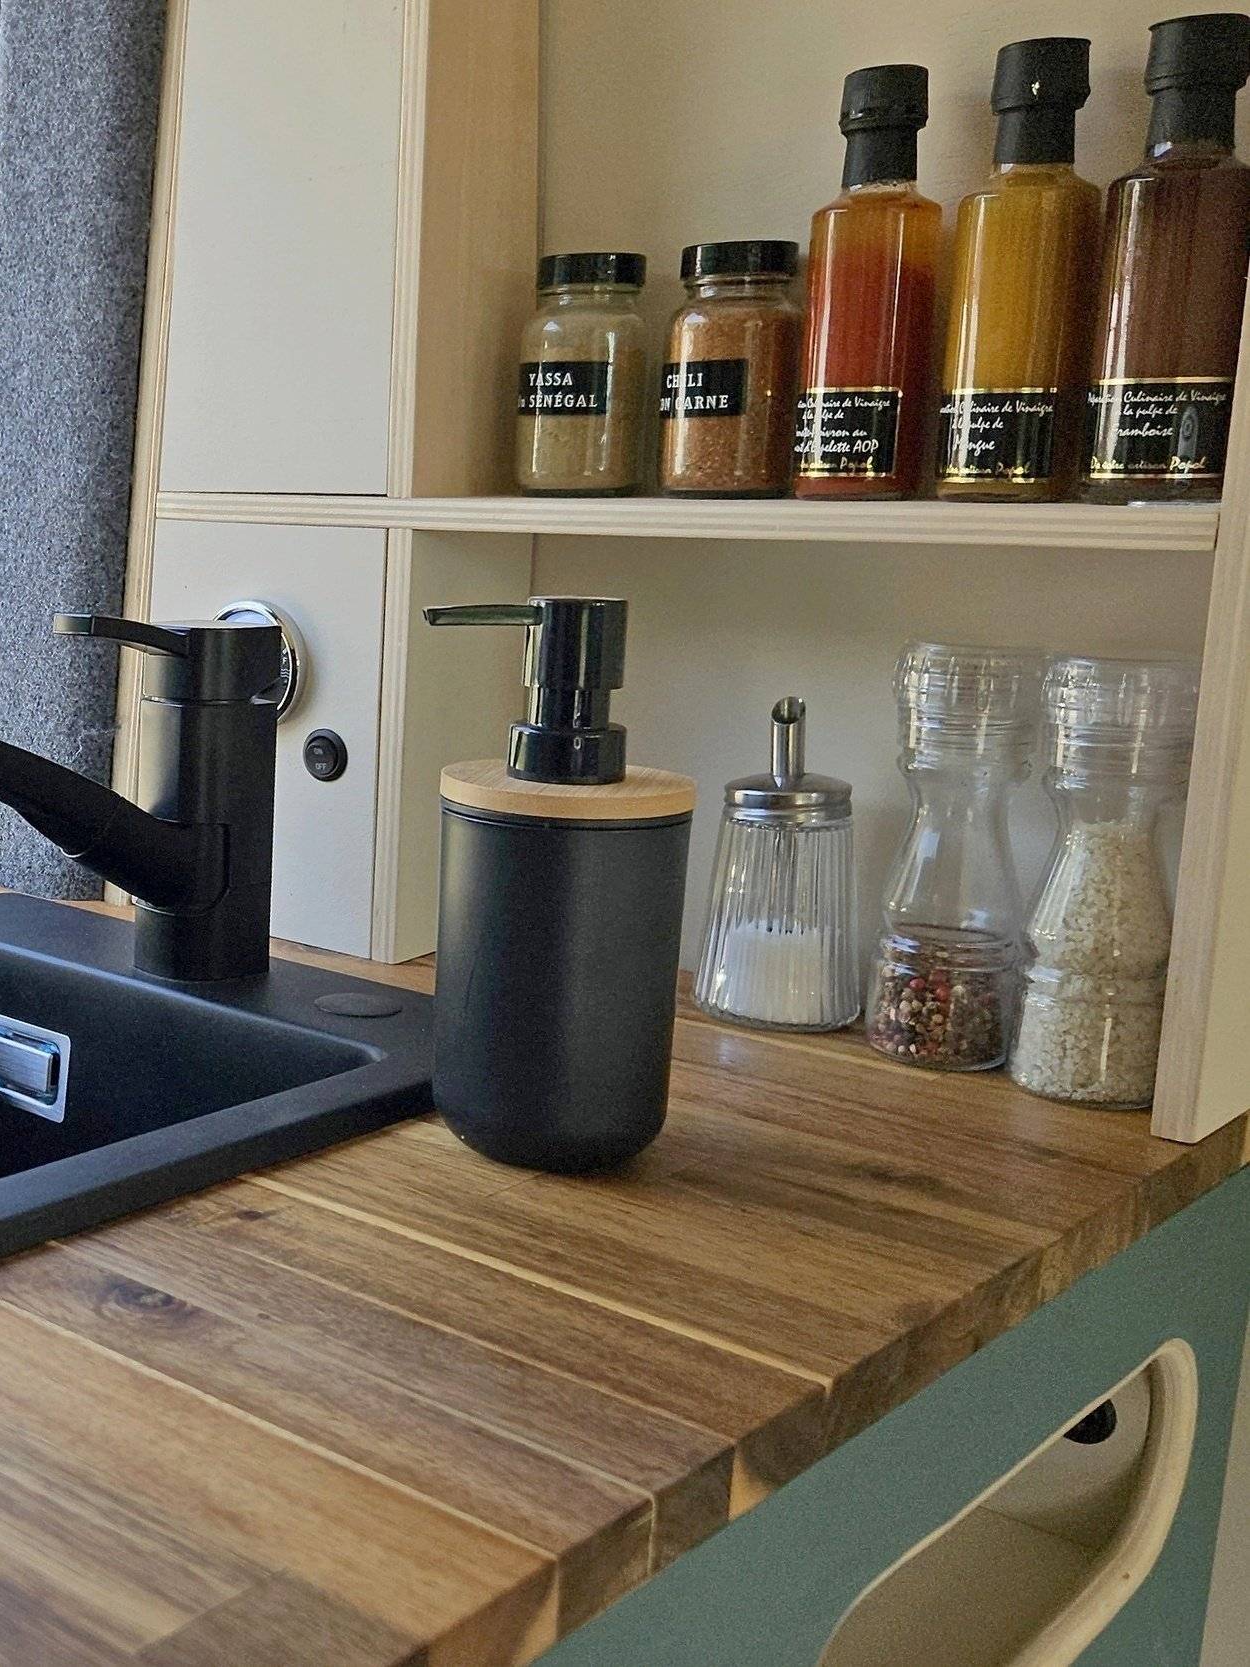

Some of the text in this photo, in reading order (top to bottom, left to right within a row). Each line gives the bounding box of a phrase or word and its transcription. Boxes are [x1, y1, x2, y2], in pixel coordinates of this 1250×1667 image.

[529, 372, 573, 386] YASSA
[666, 372, 703, 389] CHLI
[675, 394, 729, 410] CARNE
[842, 398, 852, 408] de
[854, 396, 890, 411] Vinaigre
[1123, 391, 1173, 403] Culinaire
[1175, 391, 1188, 402] de
[834, 409, 845, 419] de
[960, 401, 1000, 414] Clinaire
[1001, 400, 1013, 412] de
[1015, 400, 1053, 417] Vinaigre
[1136, 404, 1162, 418] pulpe
[1165, 404, 1178, 414] de
[966, 416, 990, 432] ulpe
[992, 416, 1004, 428] de
[1114, 422, 1174, 437] ramboise
[853, 439, 879, 453] AOP
[953, 434, 995, 456] Mngue
[315, 762, 327, 770] OFF
